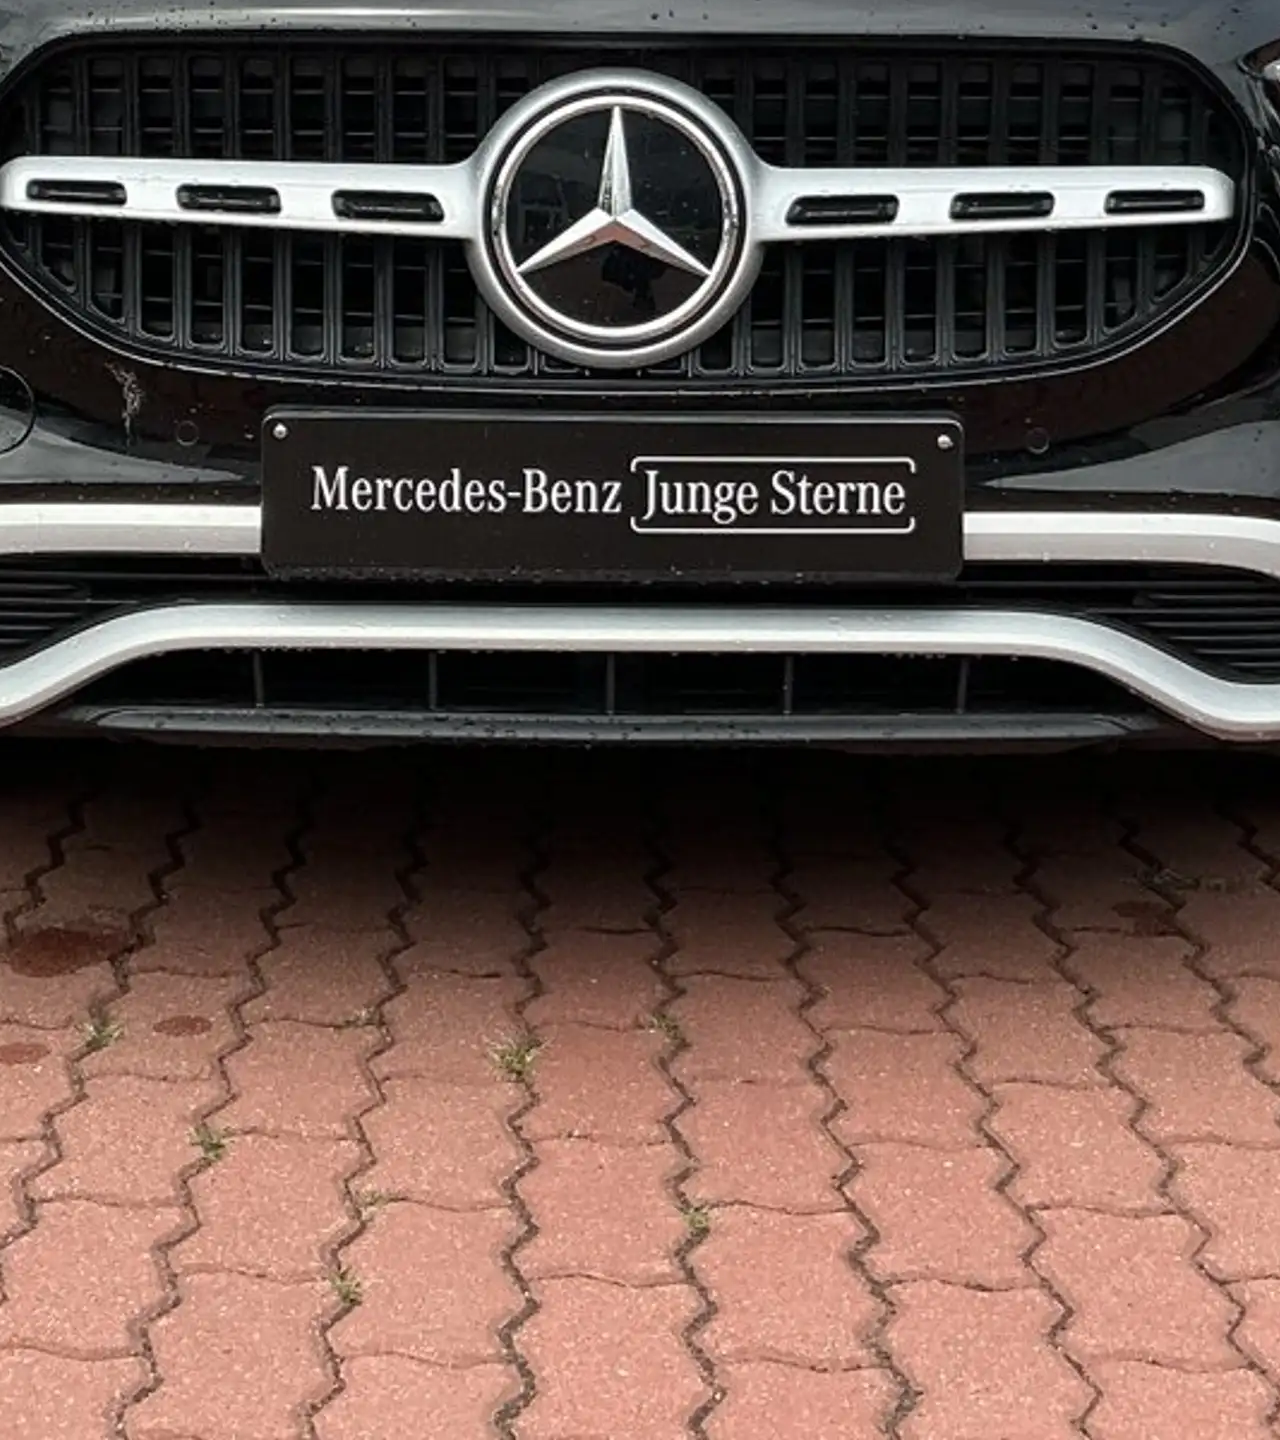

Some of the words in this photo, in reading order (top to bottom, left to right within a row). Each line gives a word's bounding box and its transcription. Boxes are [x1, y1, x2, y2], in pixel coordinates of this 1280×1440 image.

[311, 466, 622, 514] Mercedes-Benz
[642, 469, 760, 525] Junge
[771, 469, 906, 515] Sterne
